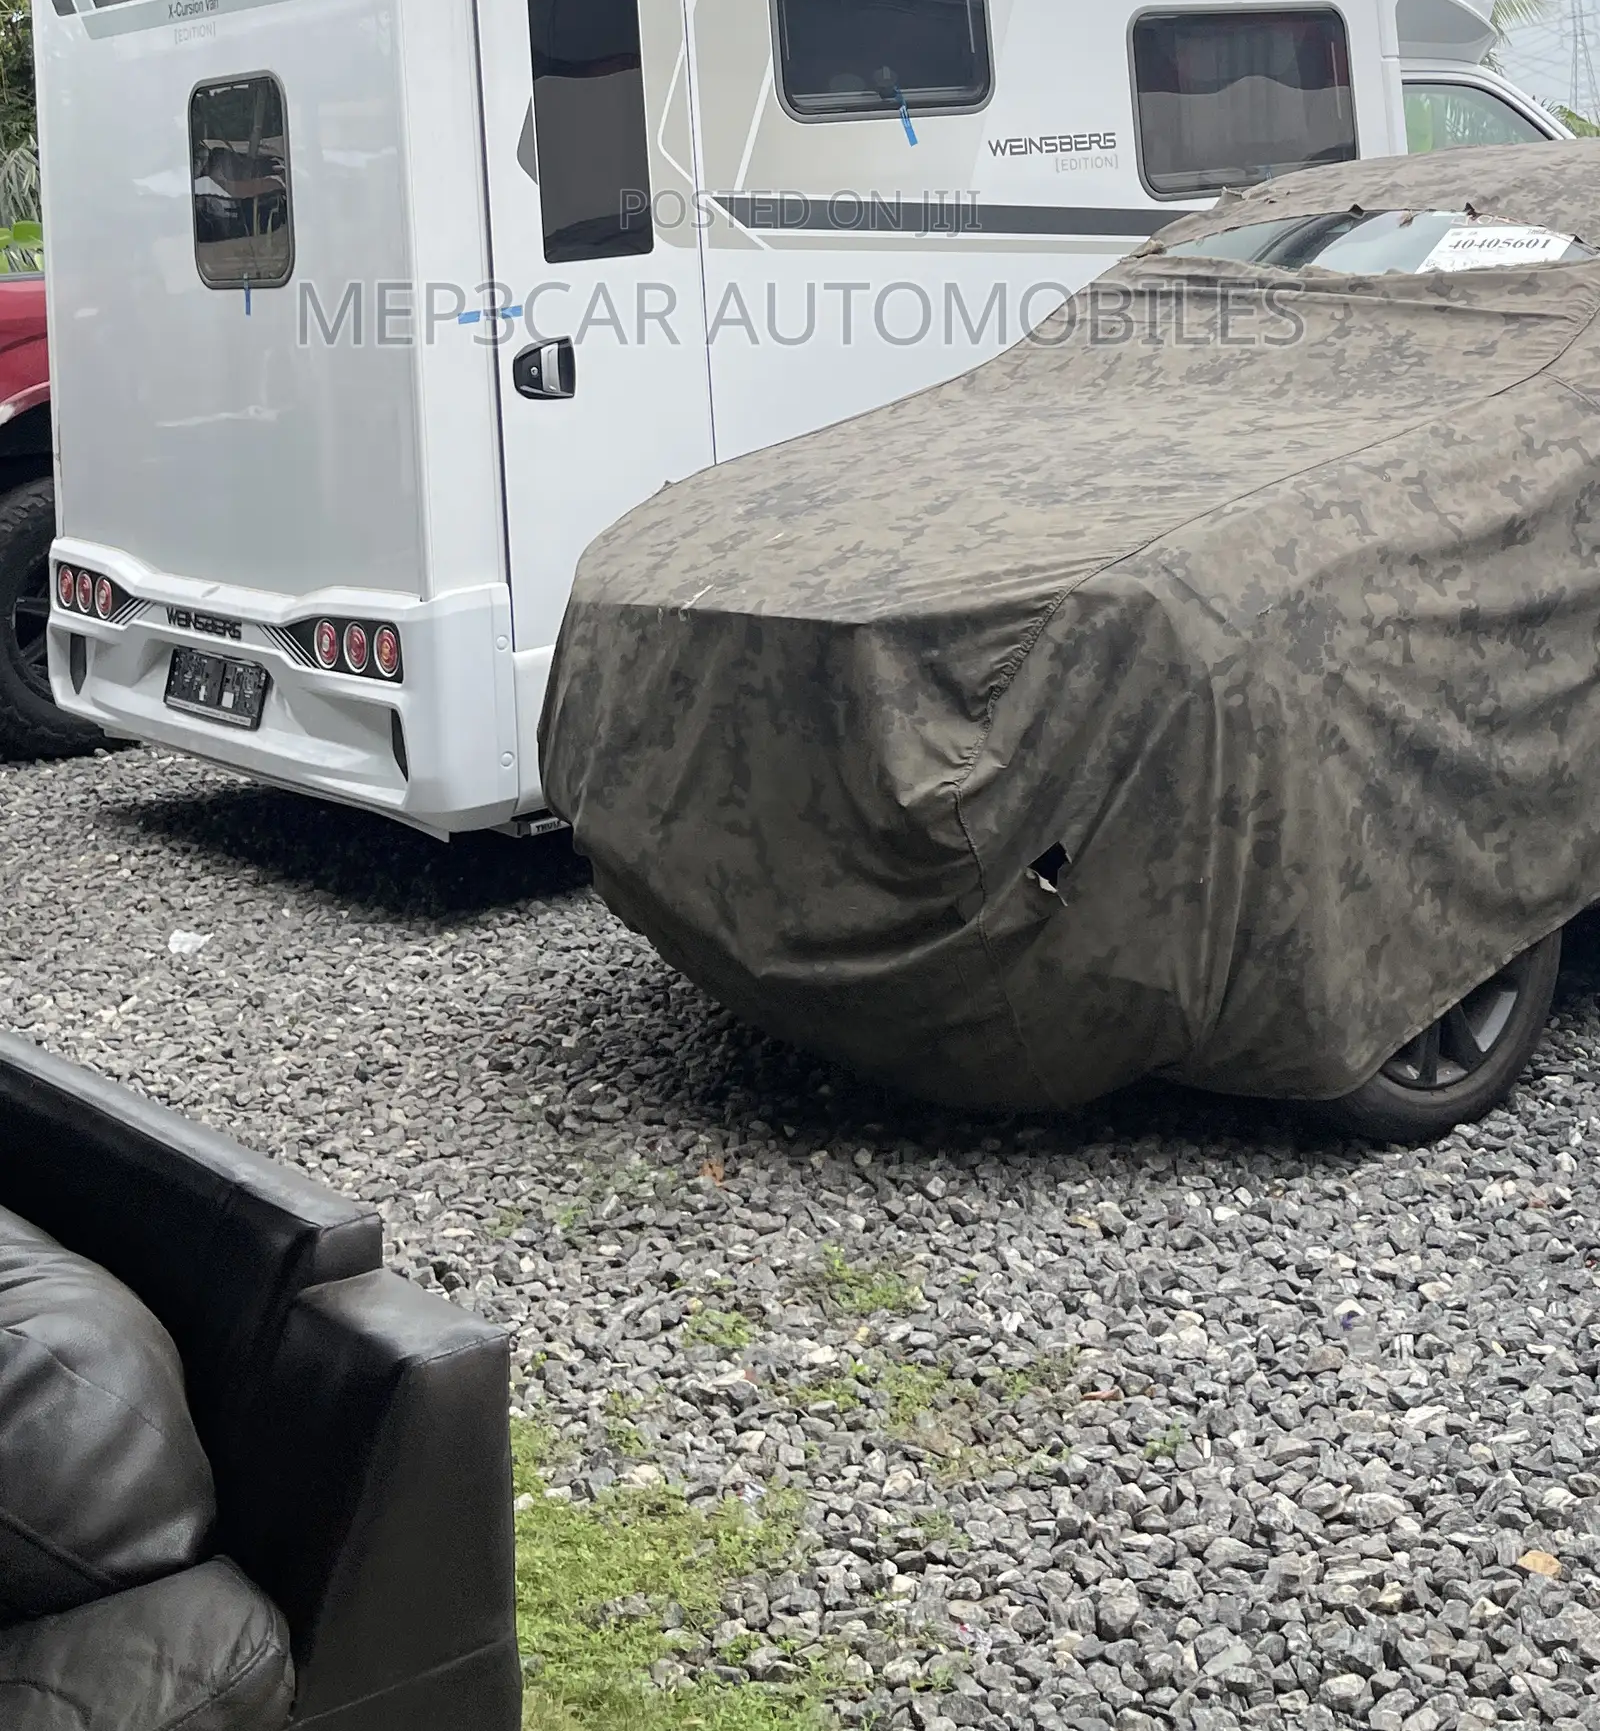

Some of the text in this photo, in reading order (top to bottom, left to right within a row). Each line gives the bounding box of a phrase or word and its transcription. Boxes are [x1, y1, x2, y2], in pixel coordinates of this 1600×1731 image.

[168, 0, 204, 19] X-Cursion
[988, 132, 1116, 157] WEINSBERG
[1448, 238, 1552, 250] 40405601
[166, 607, 242, 640] WEINSBERG
